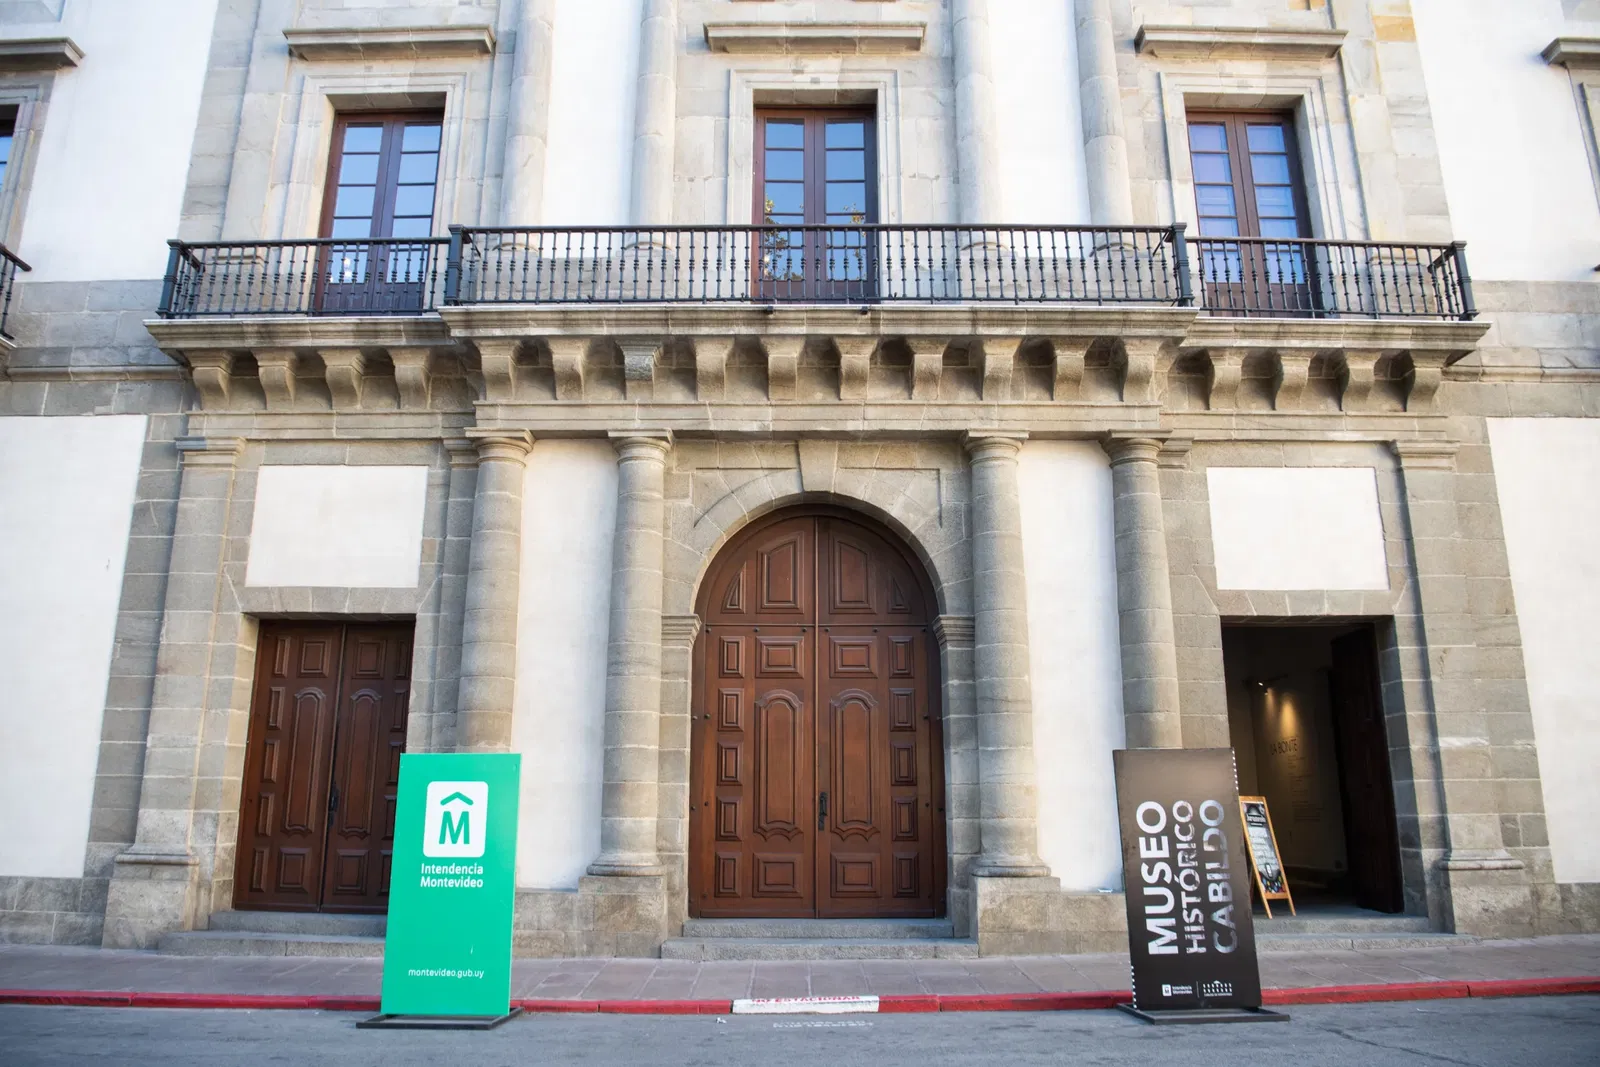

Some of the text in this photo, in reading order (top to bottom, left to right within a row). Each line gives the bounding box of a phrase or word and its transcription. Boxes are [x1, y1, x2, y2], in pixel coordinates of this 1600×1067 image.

[439, 811, 470, 844] M
[420, 876, 484, 888] Montevideo
[421, 863, 484, 875] Intendencia
[1136, 801, 1179, 955] MUSEO
[1172, 800, 1207, 954] HISTÓRICO
[1199, 800, 1238, 954] CABILDO
[408, 968, 485, 979] montevideo.gub.uy
